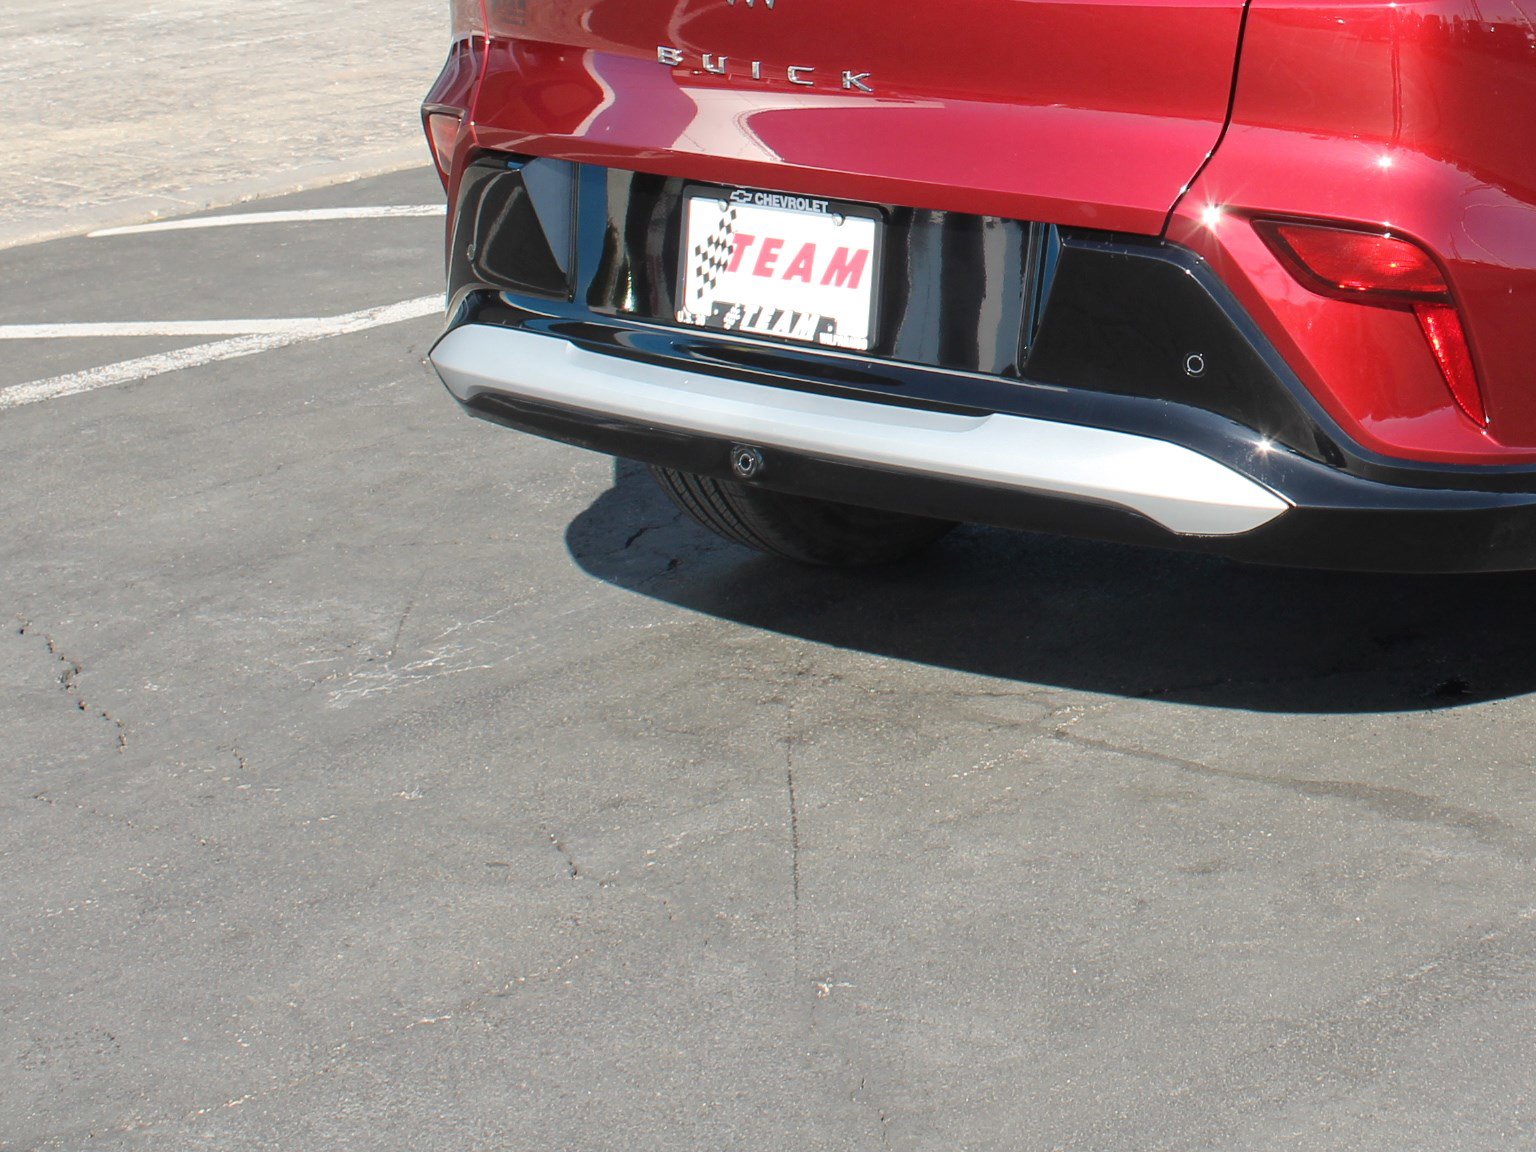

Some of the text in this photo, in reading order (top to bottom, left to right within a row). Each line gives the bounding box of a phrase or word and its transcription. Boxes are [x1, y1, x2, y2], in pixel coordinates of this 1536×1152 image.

[657, 45, 874, 92] BUICK
[754, 192, 829, 214] CHEVROLET
[727, 233, 869, 289] TEAM
